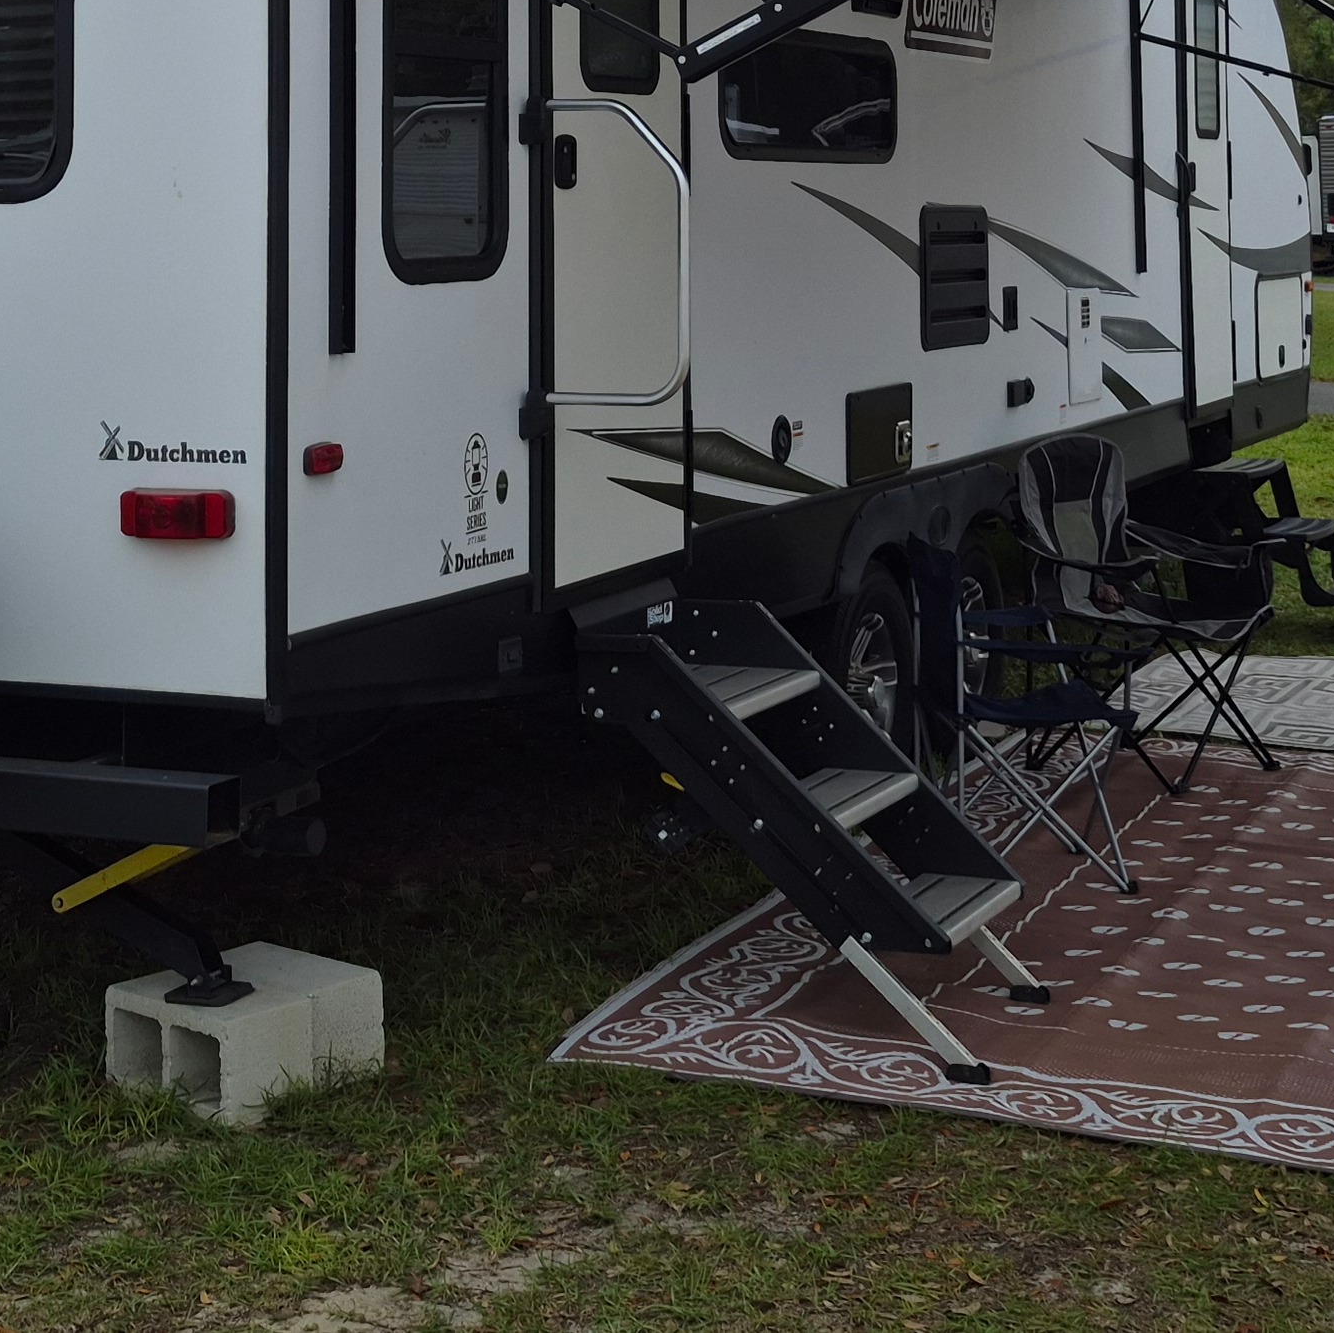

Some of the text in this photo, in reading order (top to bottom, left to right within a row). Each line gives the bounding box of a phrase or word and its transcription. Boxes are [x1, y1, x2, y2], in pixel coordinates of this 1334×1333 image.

[127, 440, 247, 464] Dutchmen
[468, 495, 485, 513] LIGHT
[467, 511, 487, 531] SERIES
[454, 547, 515, 573] Dutchmen
